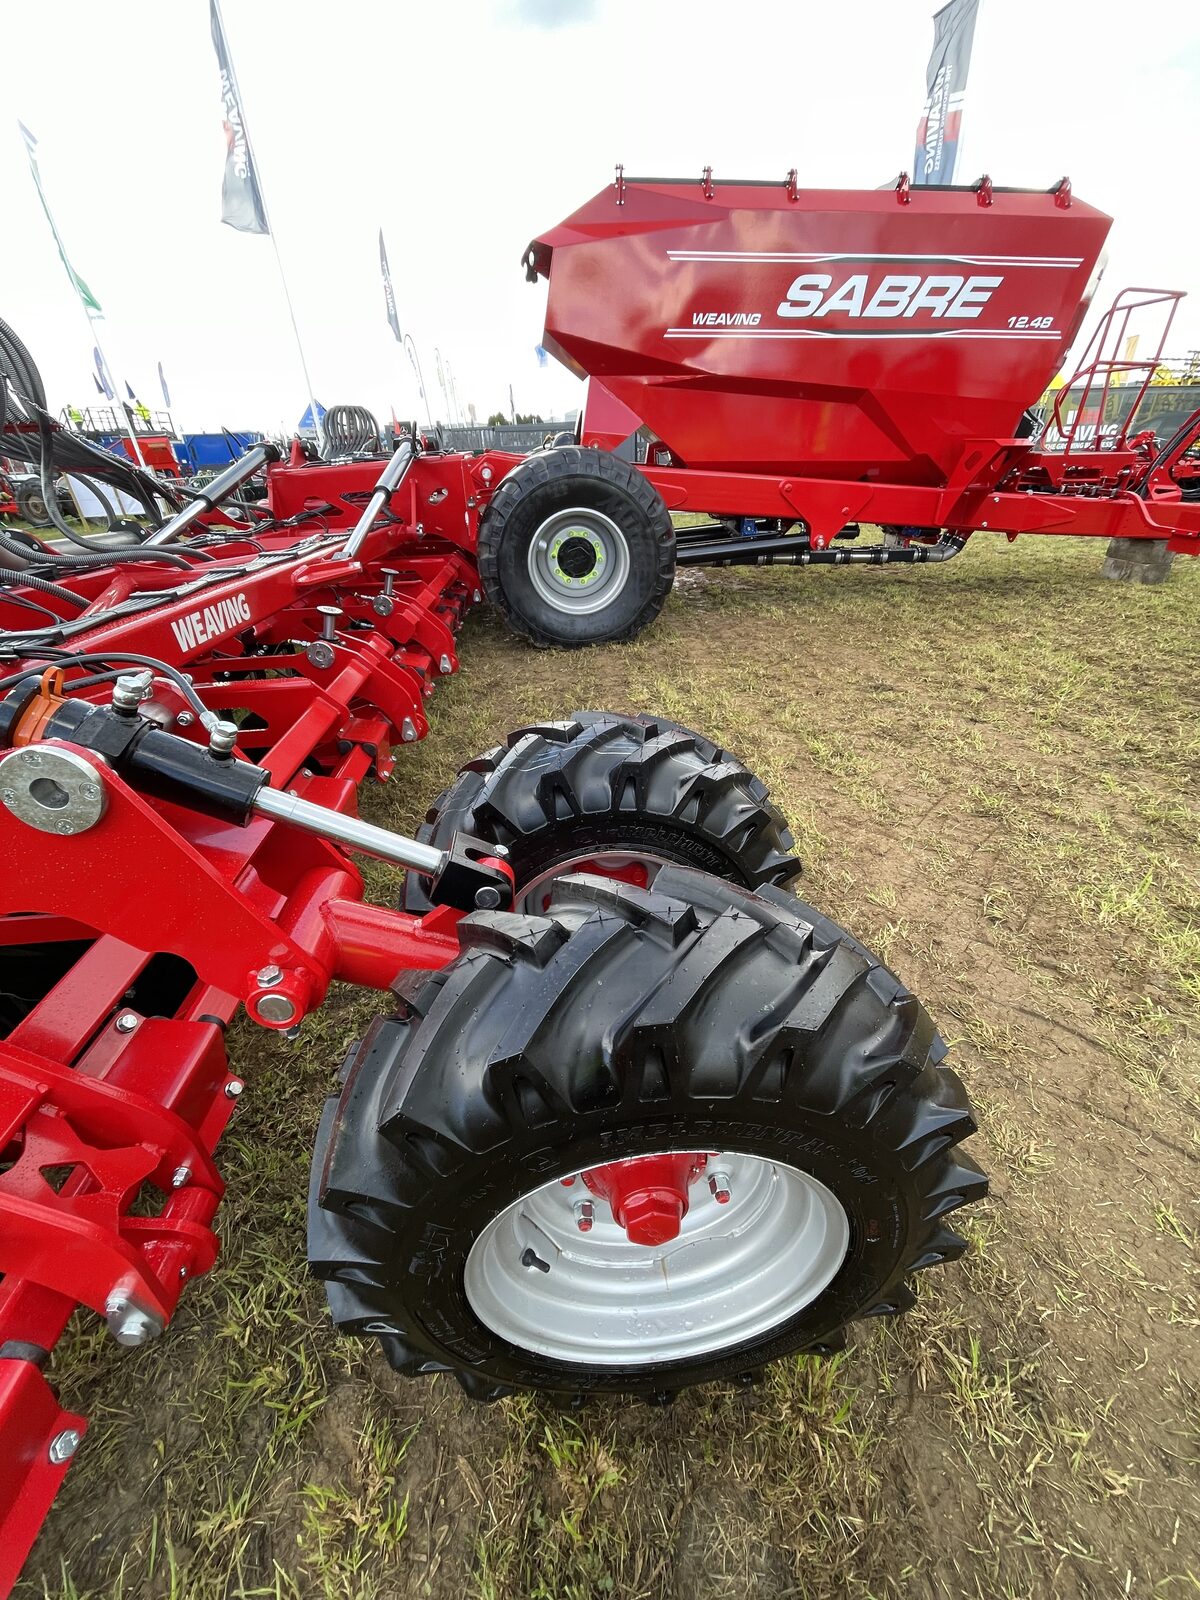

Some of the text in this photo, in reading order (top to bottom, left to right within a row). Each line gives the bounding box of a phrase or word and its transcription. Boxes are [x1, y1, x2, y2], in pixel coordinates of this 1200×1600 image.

[777, 274, 1005, 318] SABRE
[692, 313, 762, 326] WEAVING
[1008, 316, 1054, 329] 12.48
[170, 593, 251, 653] WEAVING
